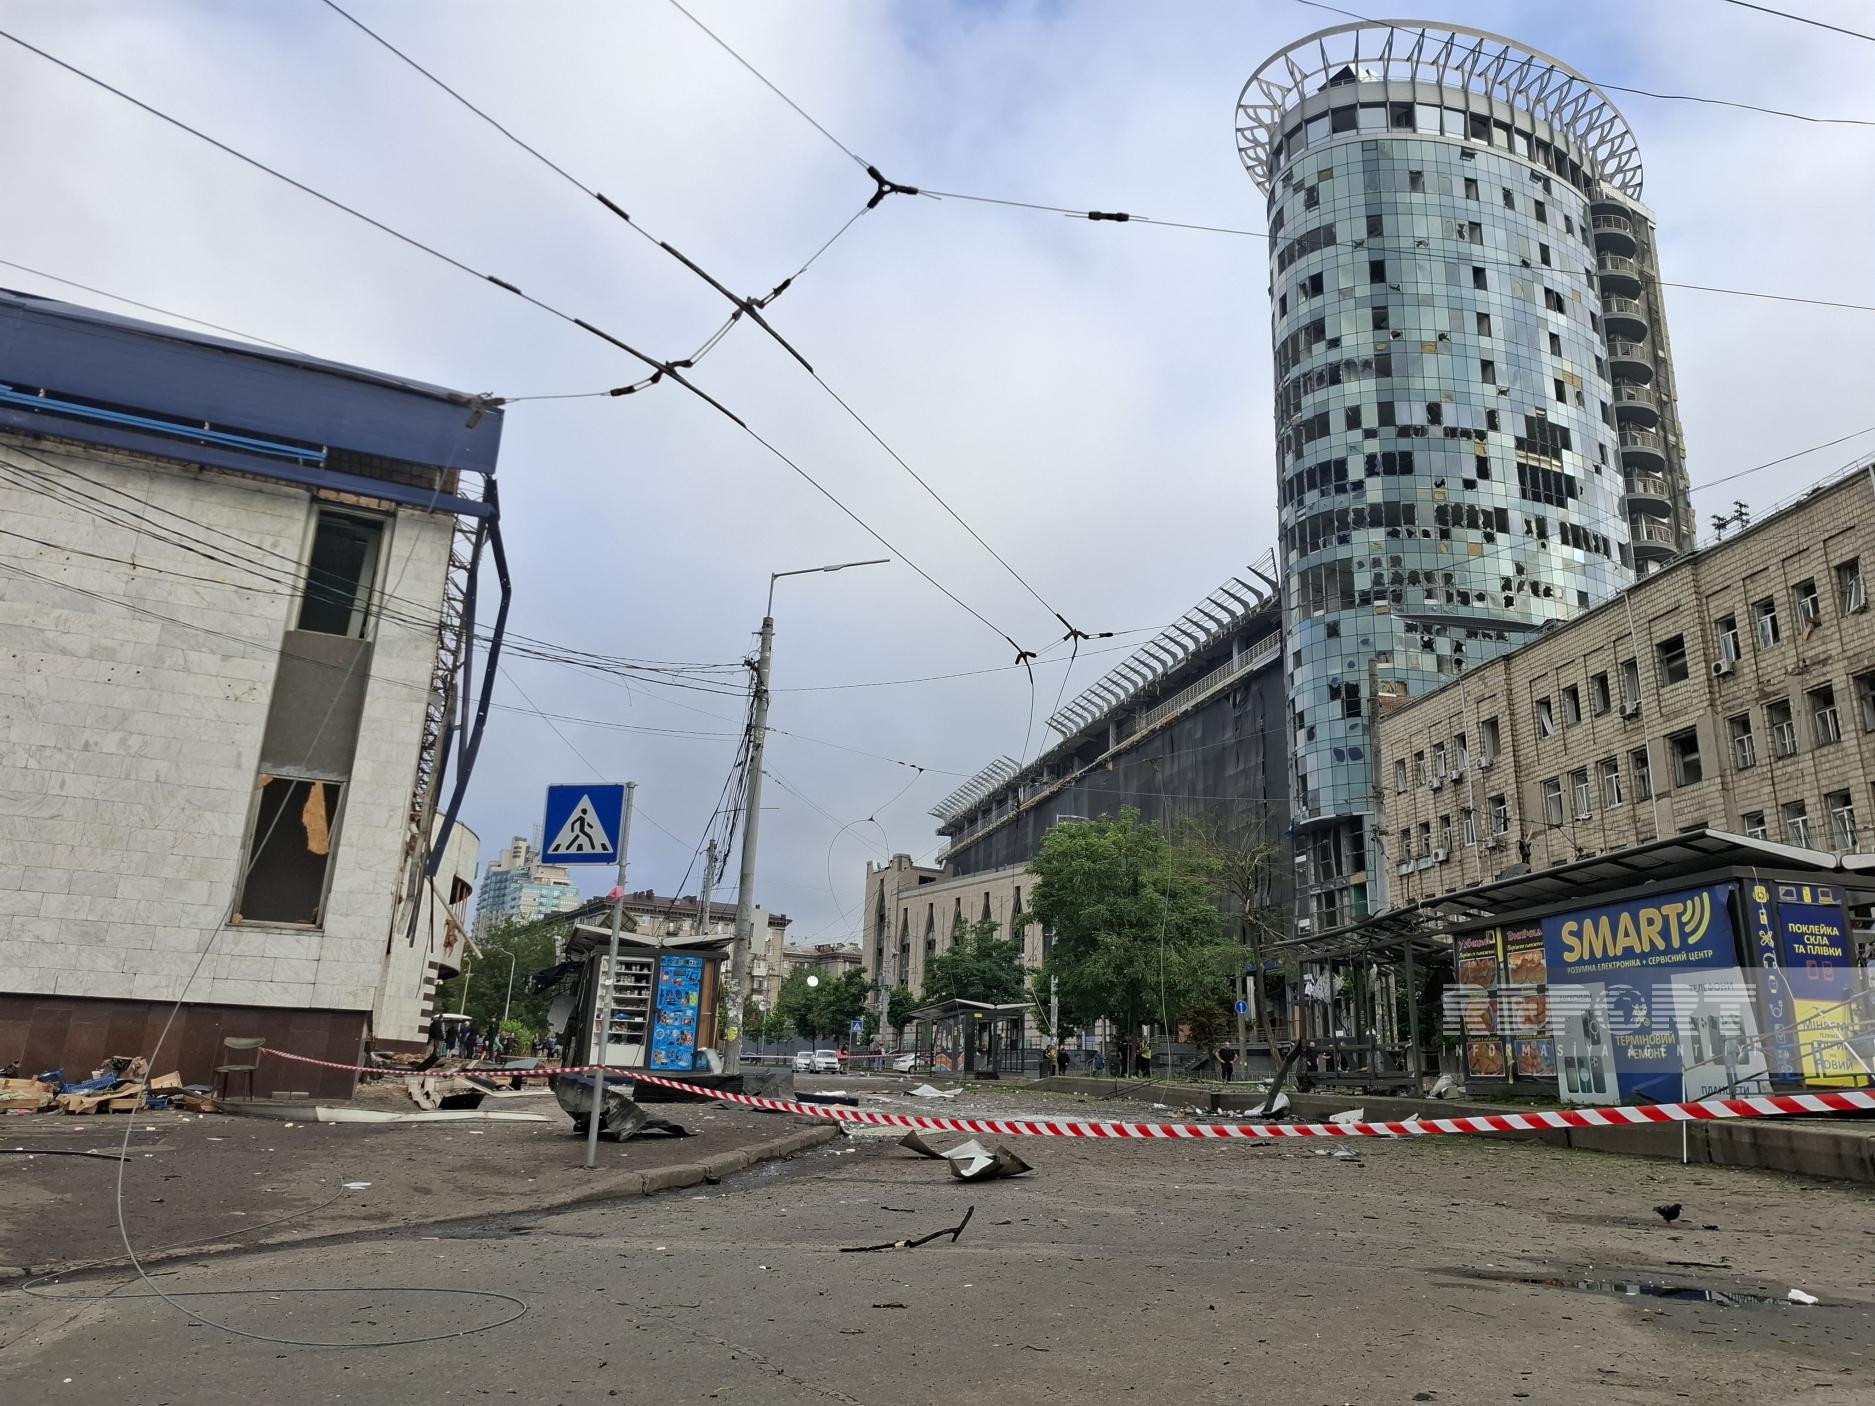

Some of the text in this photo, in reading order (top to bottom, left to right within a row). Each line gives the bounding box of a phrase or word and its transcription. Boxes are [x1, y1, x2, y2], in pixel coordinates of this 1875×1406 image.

[1561, 903, 1684, 962] SMART
[1788, 923, 1840, 936] ПОКЛЕЙКА
[1804, 935, 1829, 945] СКЛА
[1793, 944, 1842, 957] ТА ПЛІВКИ
[1567, 963, 1597, 975] РОЗУМНА
[1597, 959, 1641, 972] ЕЛЕКТРОНІКА
[1648, 951, 1687, 966] СЕРВІСНИЙ
[1688, 949, 1713, 962] ЦЕНТР
[1615, 1032, 1675, 1046] ТЕРМІНОВИЙ
[1627, 1047, 1665, 1059] РЕМОНТ
[1817, 1059, 1854, 1071] ОВИЙ
